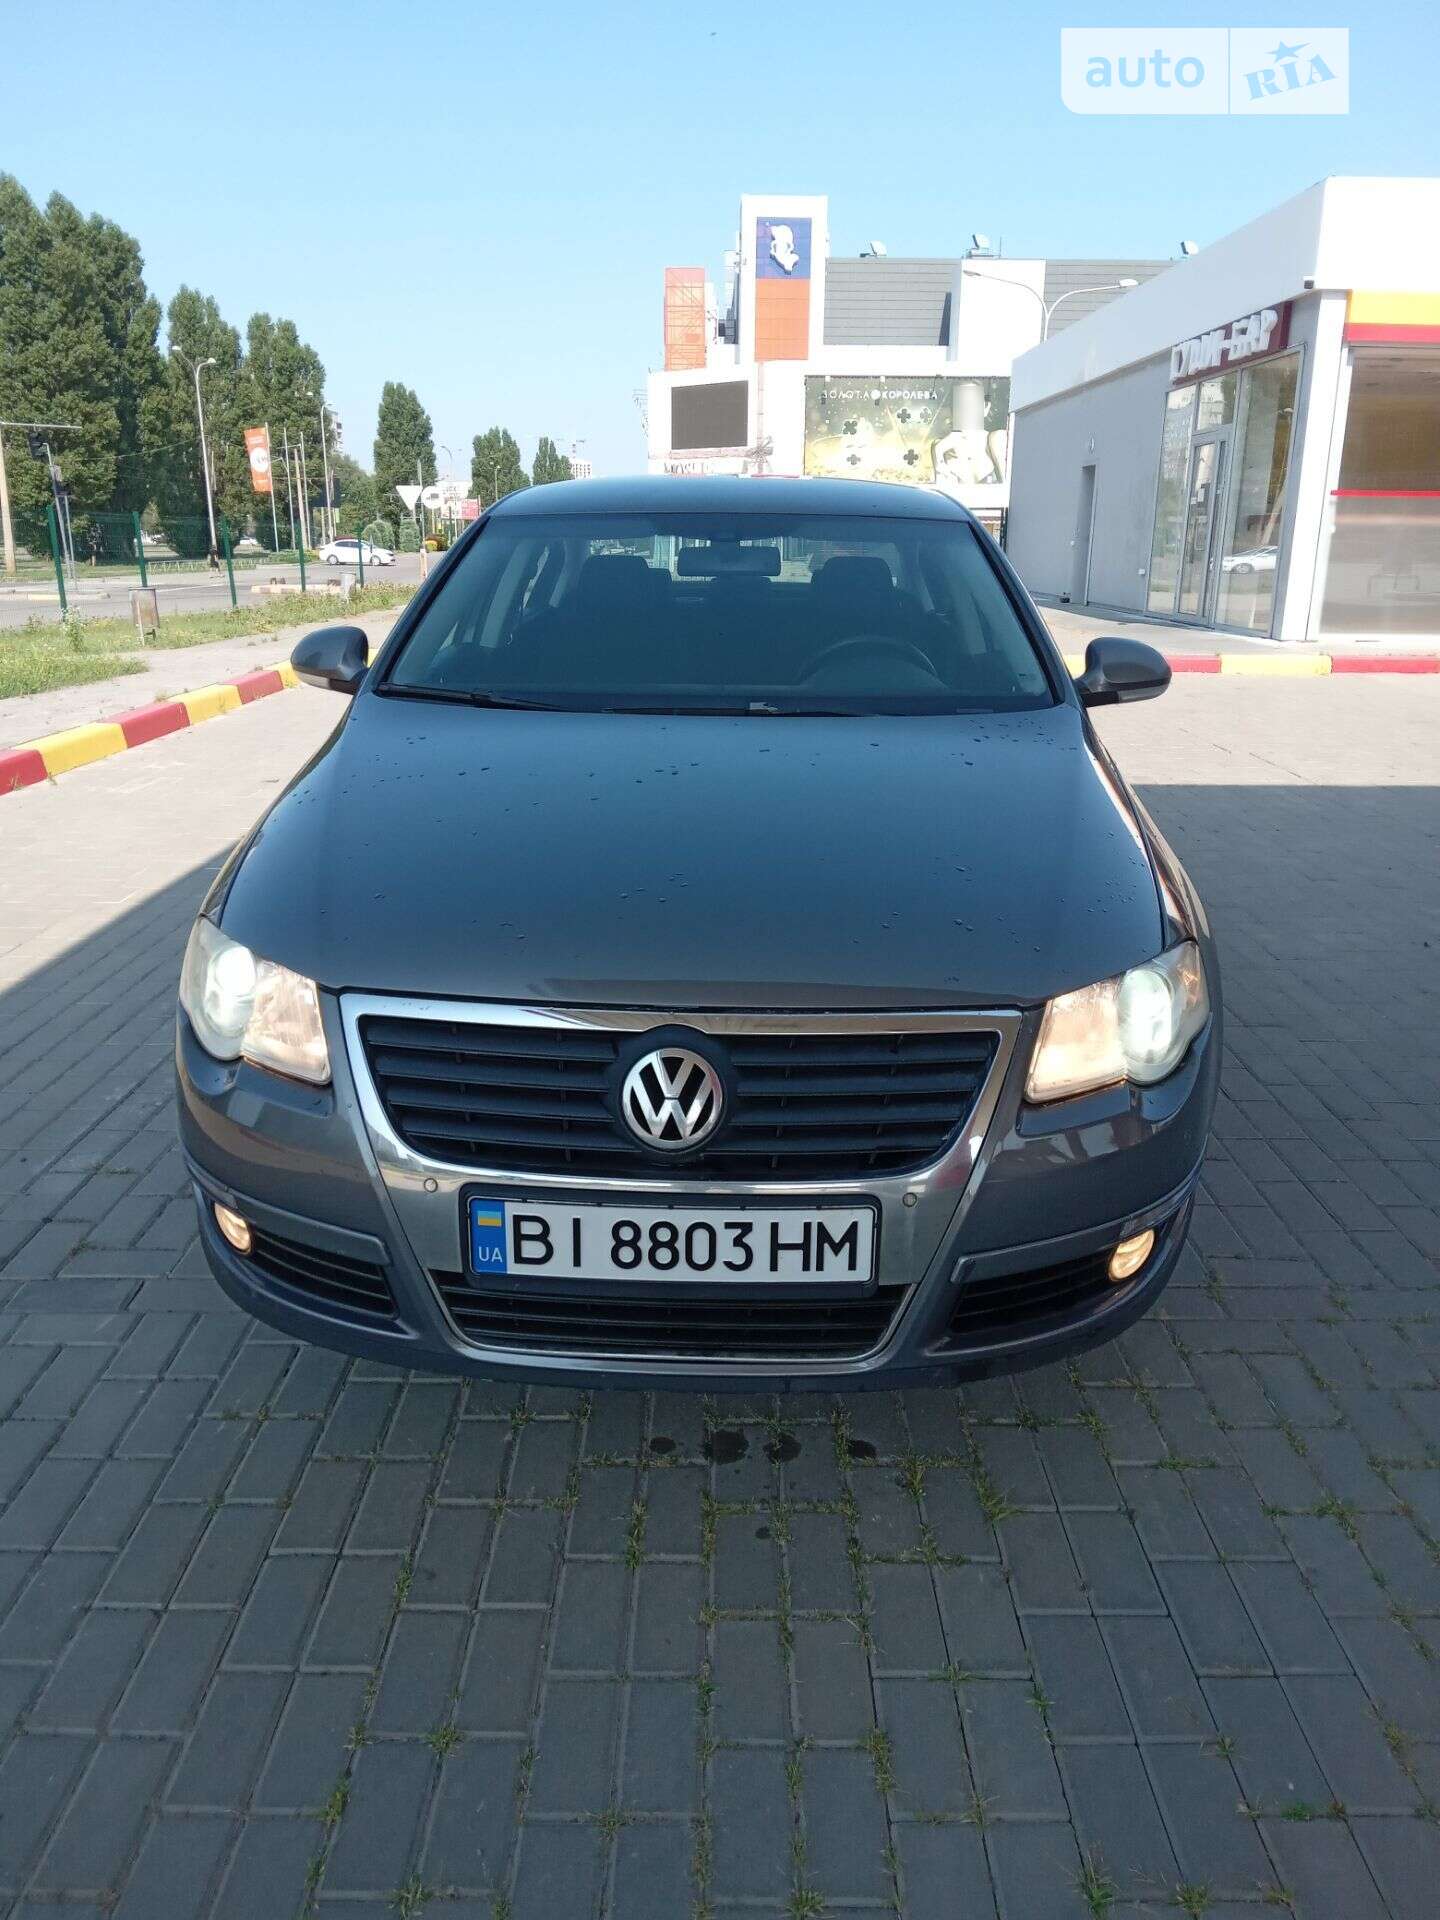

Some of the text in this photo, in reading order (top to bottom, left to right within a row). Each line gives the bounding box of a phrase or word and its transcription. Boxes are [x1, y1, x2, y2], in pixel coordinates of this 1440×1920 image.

[881, 390, 938, 400] КОРОЛЕВА
[610, 1219, 754, 1272] 8803
[769, 1220, 859, 1272] HM
[477, 1246, 504, 1264] UA
